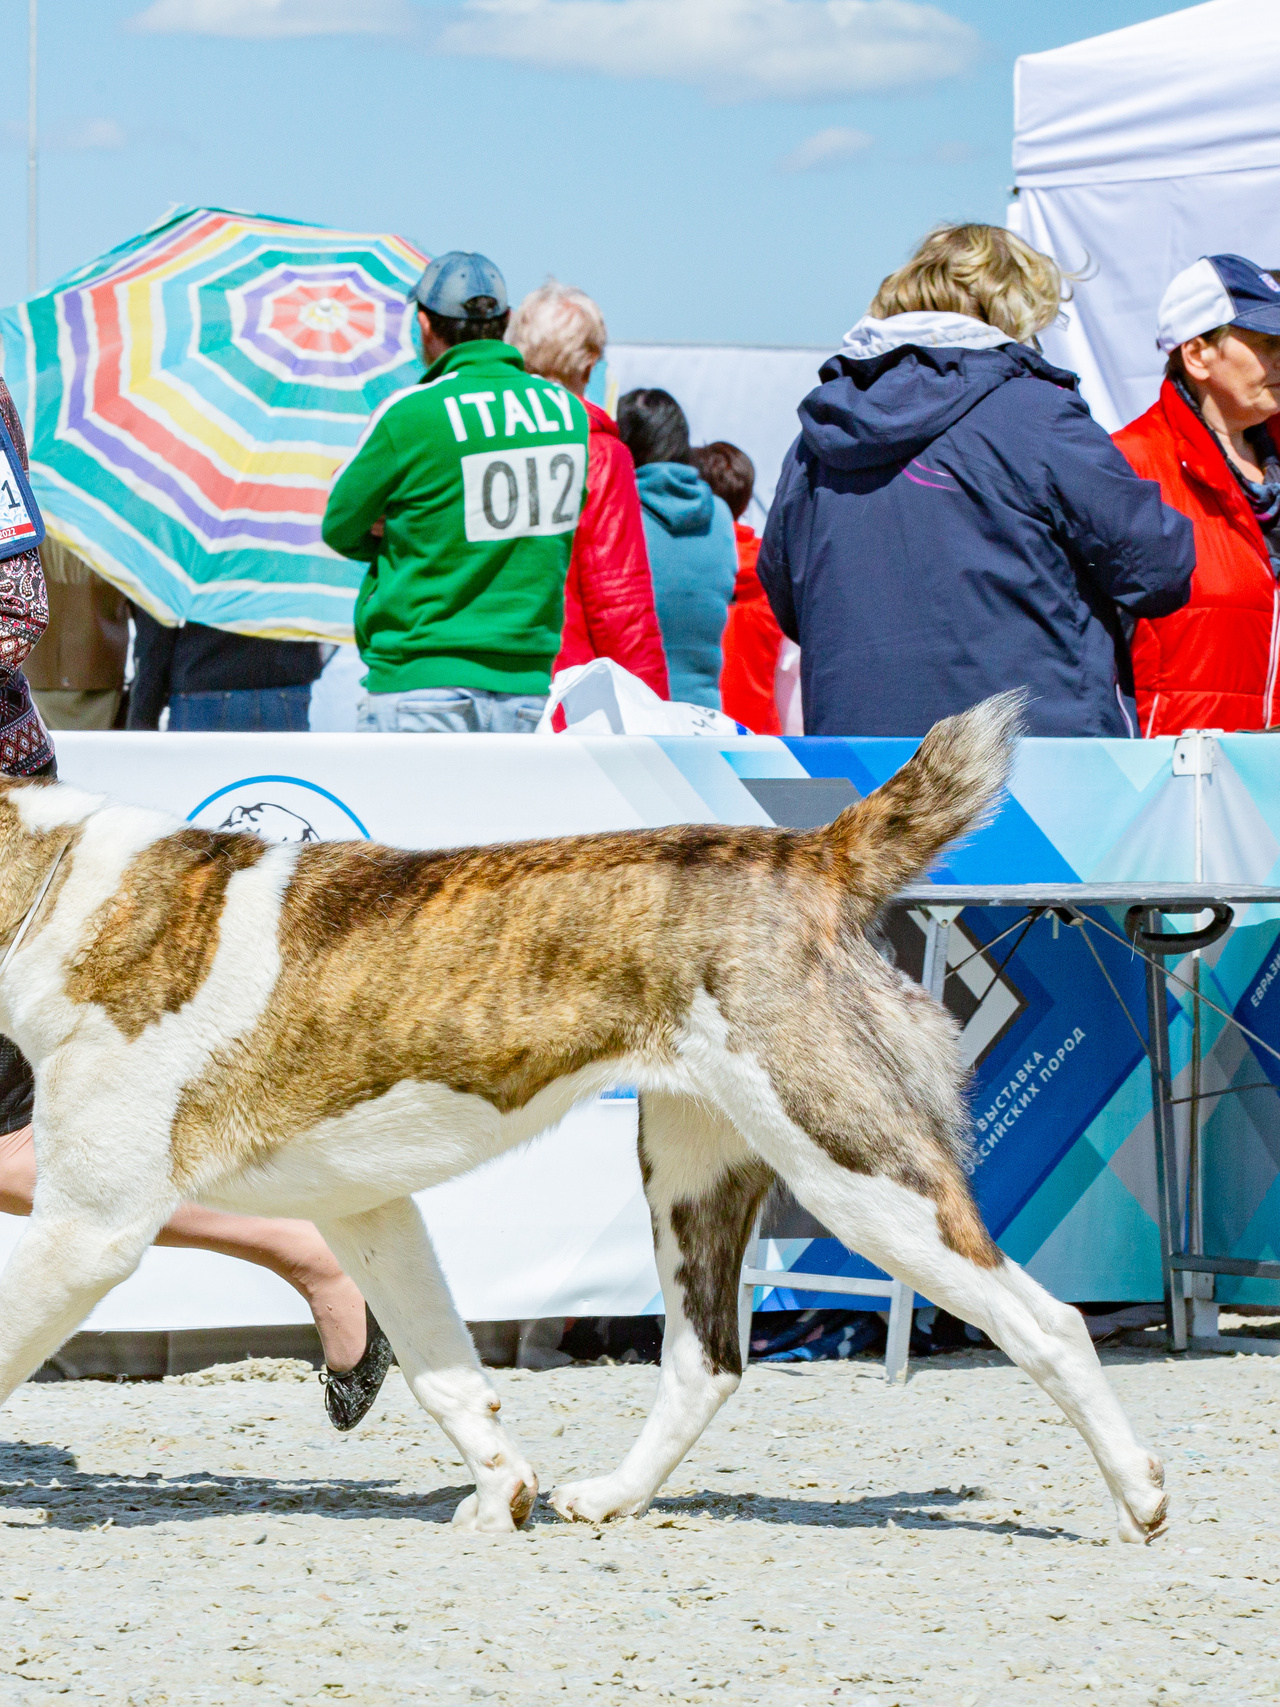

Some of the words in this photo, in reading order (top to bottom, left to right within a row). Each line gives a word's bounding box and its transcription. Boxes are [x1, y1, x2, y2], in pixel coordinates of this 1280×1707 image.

[444, 388, 574, 442] ITALY
[482, 453, 575, 530] 012
[1250, 947, 1280, 1008] ЕВРАЗИ
[965, 1082, 1040, 1175] ОСИЙСКИХ
[1039, 1027, 1086, 1082] ПОРОД
[976, 1051, 1044, 1132] ВЫСТАВКА
